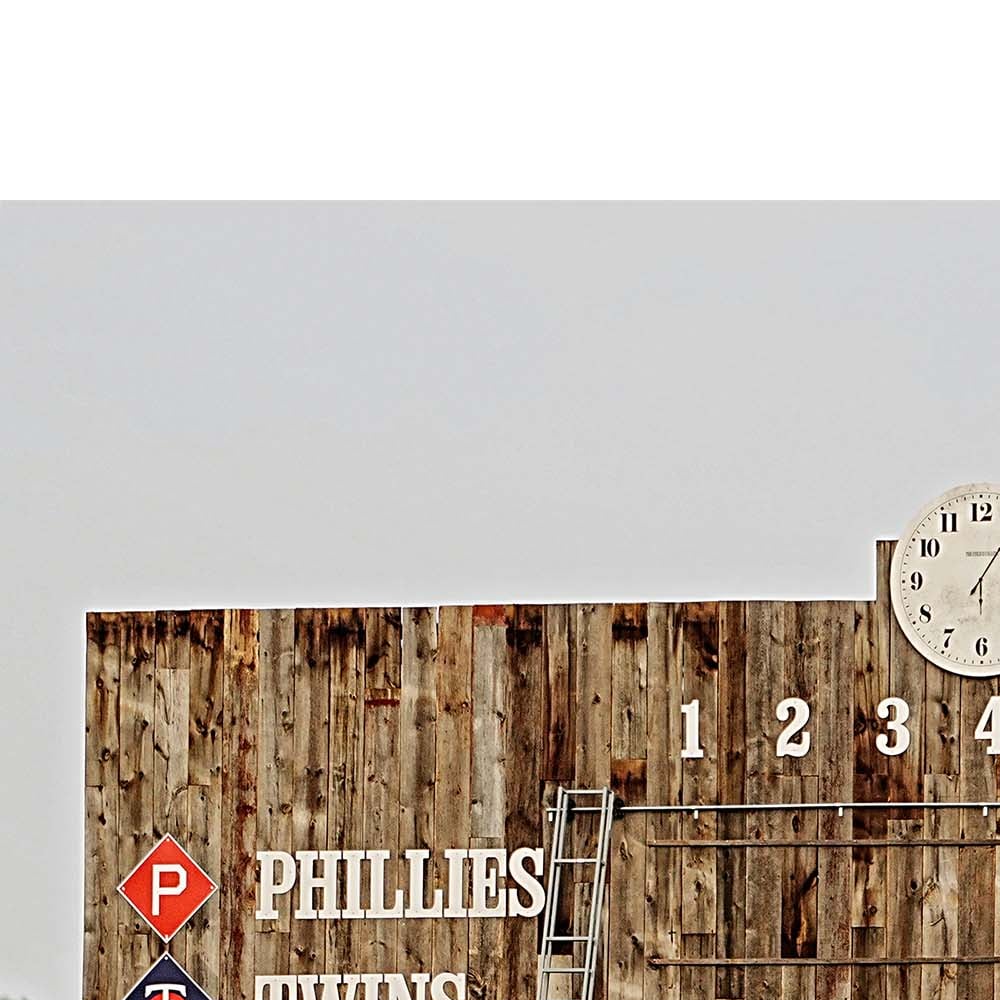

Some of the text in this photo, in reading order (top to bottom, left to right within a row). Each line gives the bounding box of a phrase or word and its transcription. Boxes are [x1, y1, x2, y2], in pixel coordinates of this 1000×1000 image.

[971, 502, 993, 522] 12
[941, 512, 958, 533] 11
[920, 538, 940, 558] 10
[910, 571, 923, 591] 9
[919, 604, 932, 624] 8
[943, 628, 955, 648] 7
[975, 637, 988, 657] 6
[680, 699, 704, 759] 1
[775, 698, 811, 757] 2
[876, 697, 911, 756] 3
[151, 864, 188, 916] P
[255, 847, 546, 919] PHILLIES
